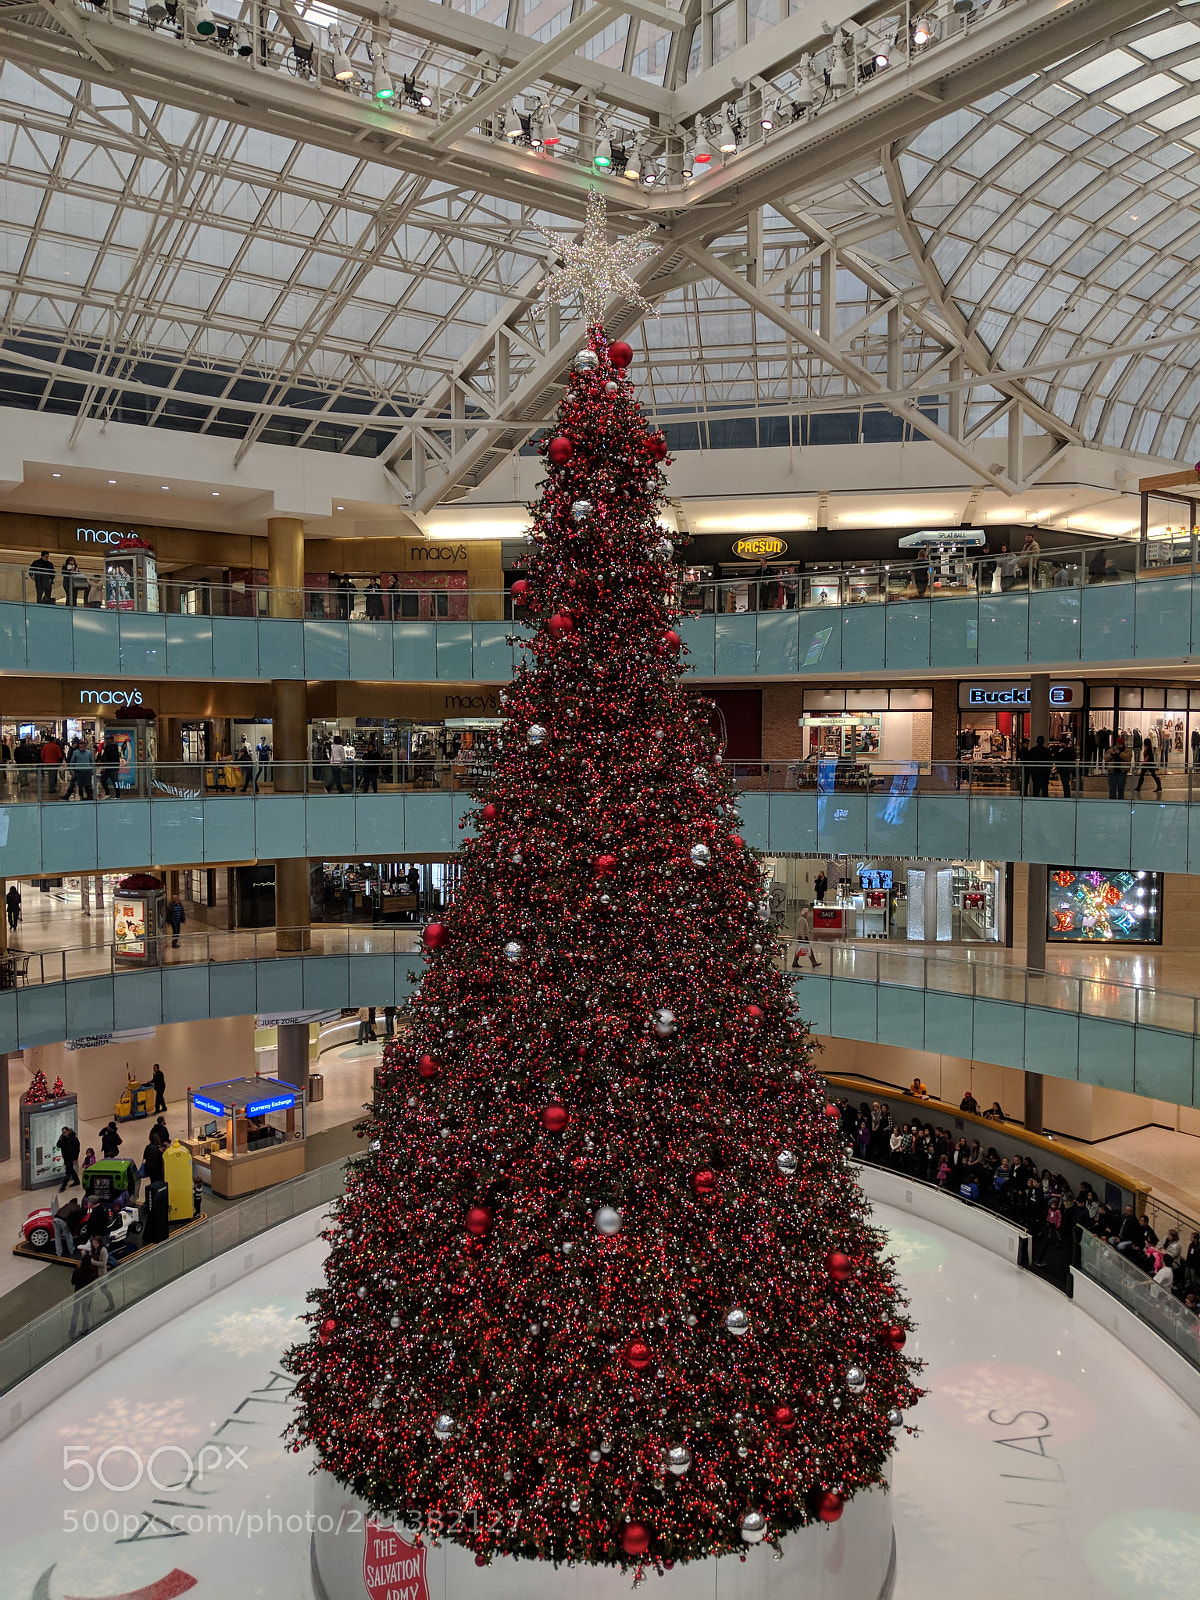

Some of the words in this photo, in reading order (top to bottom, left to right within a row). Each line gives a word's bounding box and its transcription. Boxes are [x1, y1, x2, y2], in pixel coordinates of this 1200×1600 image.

[411, 544, 468, 563] macy's
[80, 688, 143, 708] macy's
[445, 694, 497, 712] macy's
[969, 688, 1032, 704] Buckl
[281, 1017, 299, 1025] ZONE
[70, 1039, 110, 1051] DOUGHNUT
[250, 1102, 271, 1113] Currency
[271, 1098, 292, 1108] Exchange
[373, 1537, 398, 1559] THE
[366, 1553, 421, 1588] SALVATION
